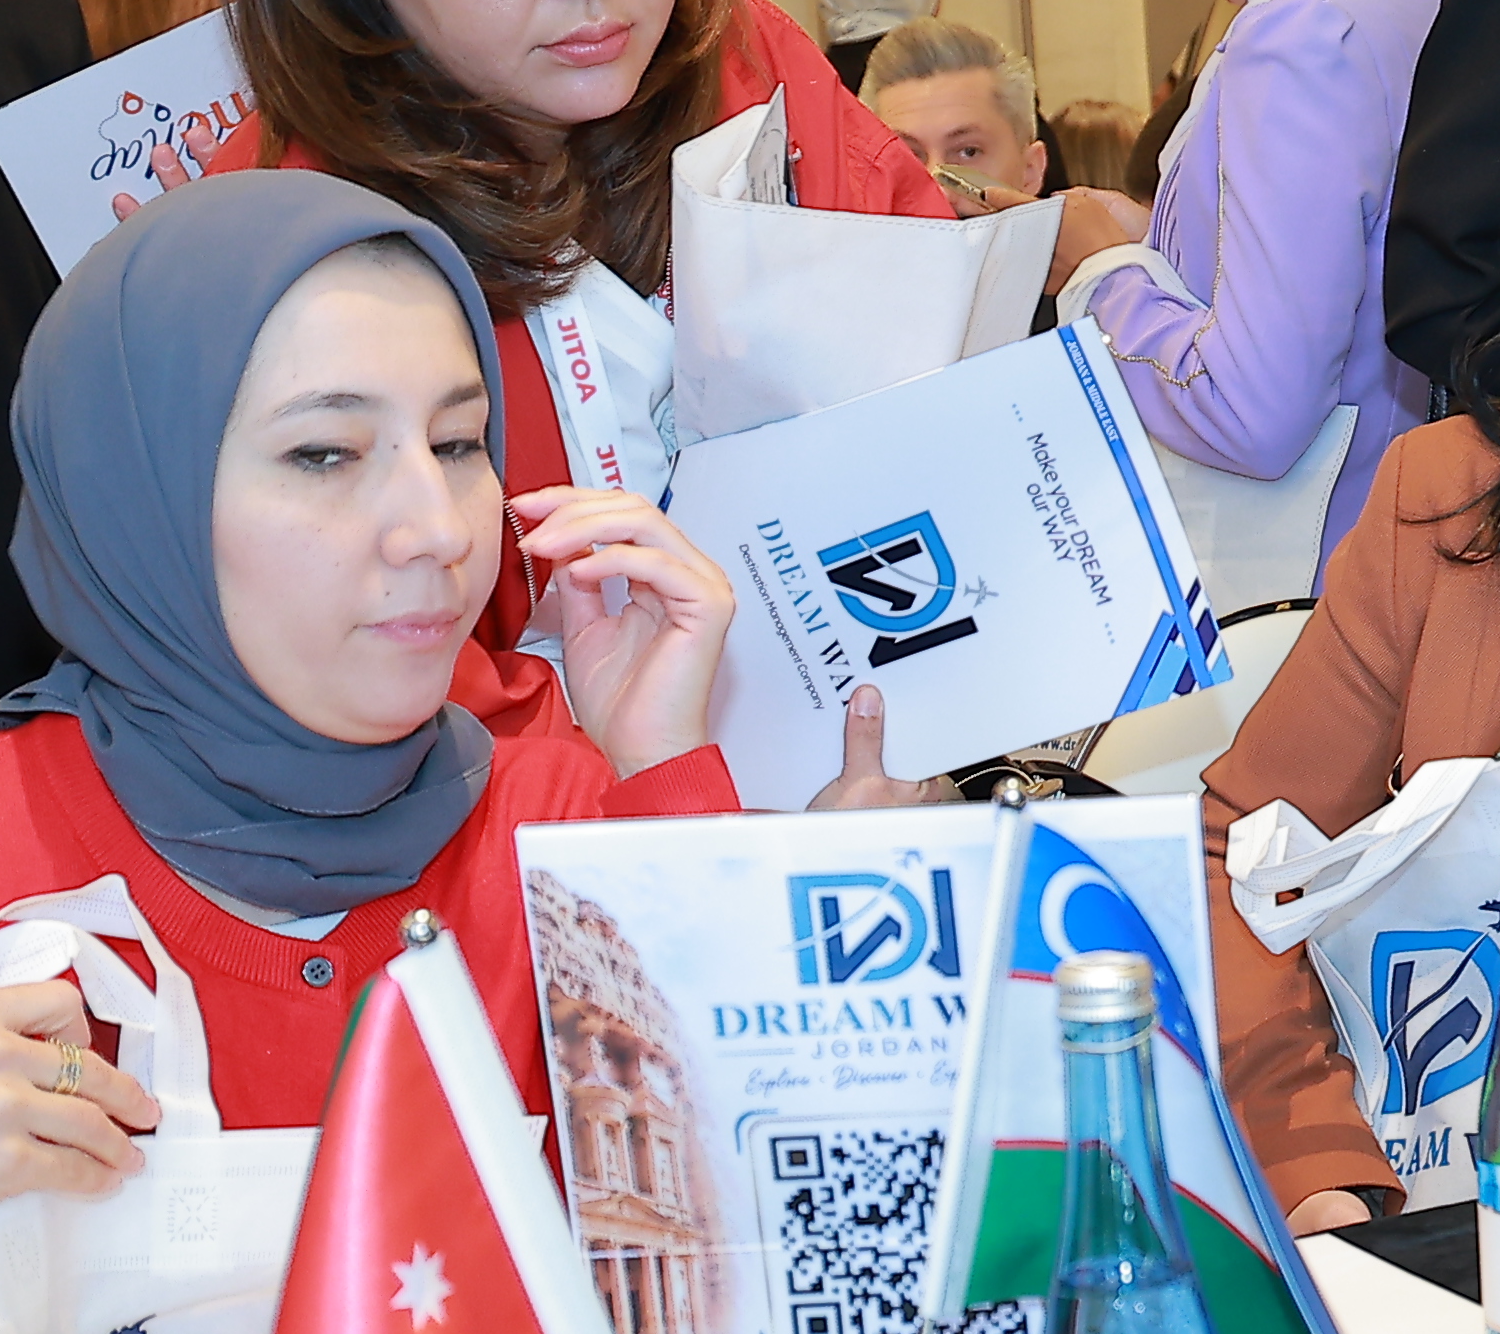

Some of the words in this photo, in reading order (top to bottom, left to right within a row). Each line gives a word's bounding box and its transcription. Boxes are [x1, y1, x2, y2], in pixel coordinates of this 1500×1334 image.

[557, 316, 597, 404] JITOA
[1066, 338, 1091, 379] JORDAN
[596, 444, 624, 493] JIT
[1026, 432, 1059, 483] Make
[1045, 483, 1079, 535] your
[1065, 529, 1113, 606] DREAM
[1026, 483, 1051, 512] our
[1042, 514, 1075, 561] WAY
[756, 518, 831, 635] DREAM
[738, 543, 771, 602] Destination
[765, 600, 803, 664] Management
[796, 663, 825, 710] Company
[713, 998, 915, 1038] DREAM
[811, 1036, 948, 1059] JORDAN
[1385, 1127, 1453, 1176] EAM
